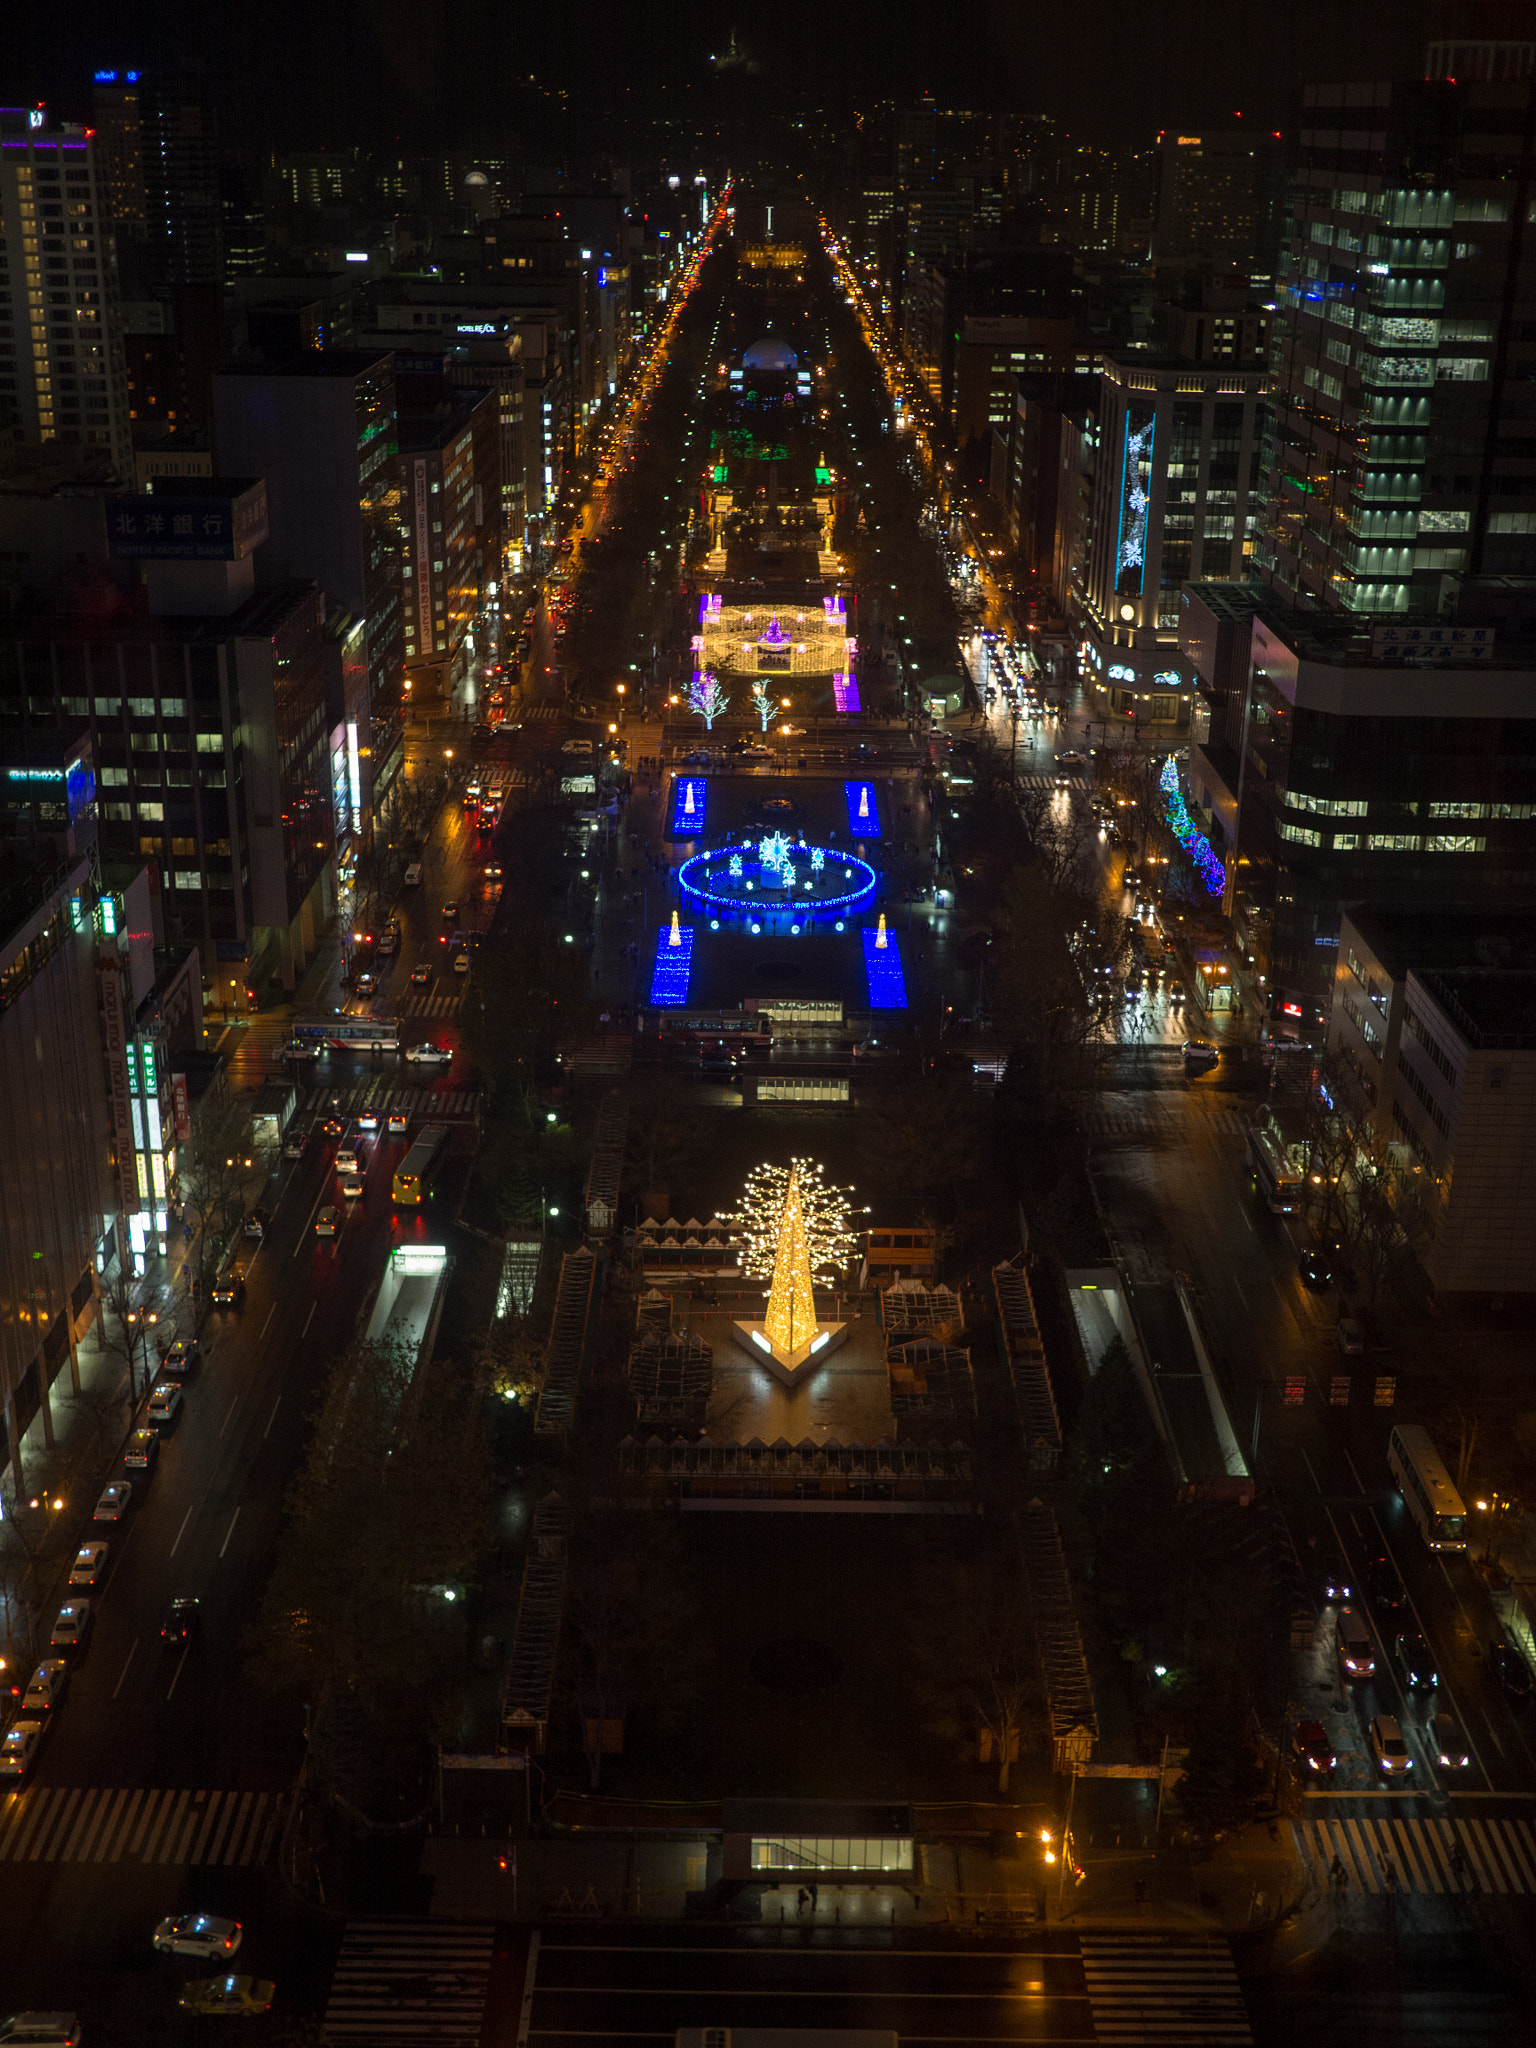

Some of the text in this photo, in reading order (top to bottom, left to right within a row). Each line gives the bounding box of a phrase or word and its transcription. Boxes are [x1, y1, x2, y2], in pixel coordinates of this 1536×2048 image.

[457, 325, 474, 333] HOTEL
[115, 513, 223, 535] 北洋銀行
[1384, 629, 1486, 641] 北海道新聞
